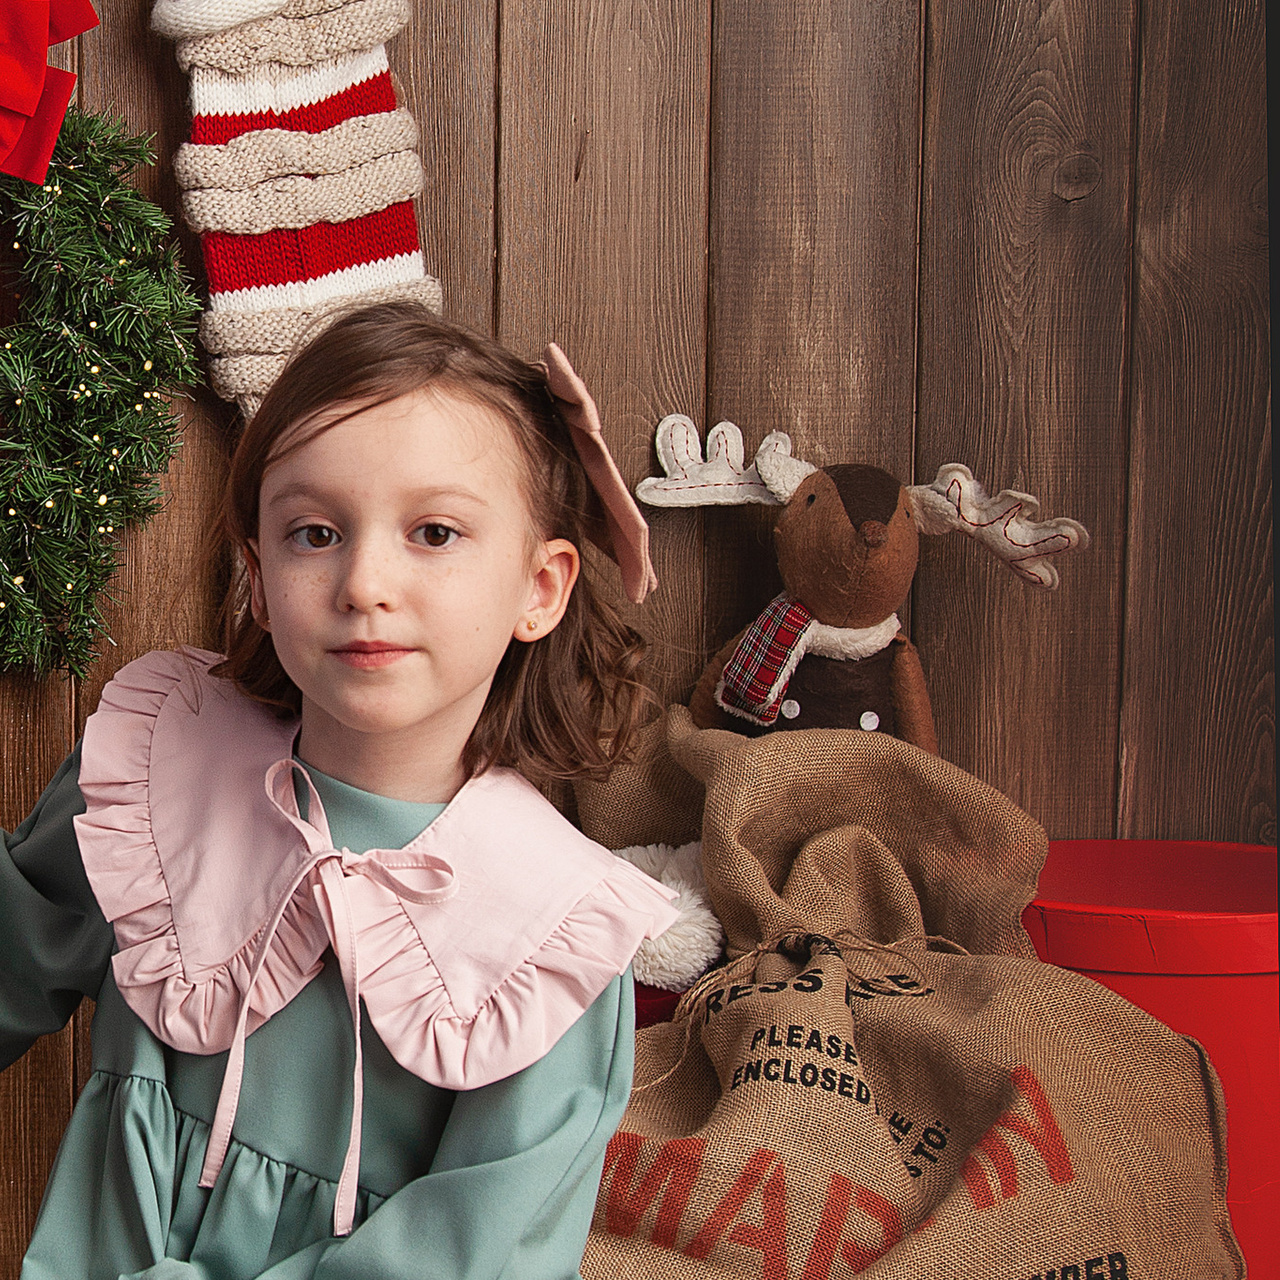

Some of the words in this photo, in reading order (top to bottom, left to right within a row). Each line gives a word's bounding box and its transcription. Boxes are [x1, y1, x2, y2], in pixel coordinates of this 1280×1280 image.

[750, 1025, 859, 1066] PLEASE
[730, 1059, 871, 1104] ENCLOSED
[912, 1120, 951, 1162] TO:
